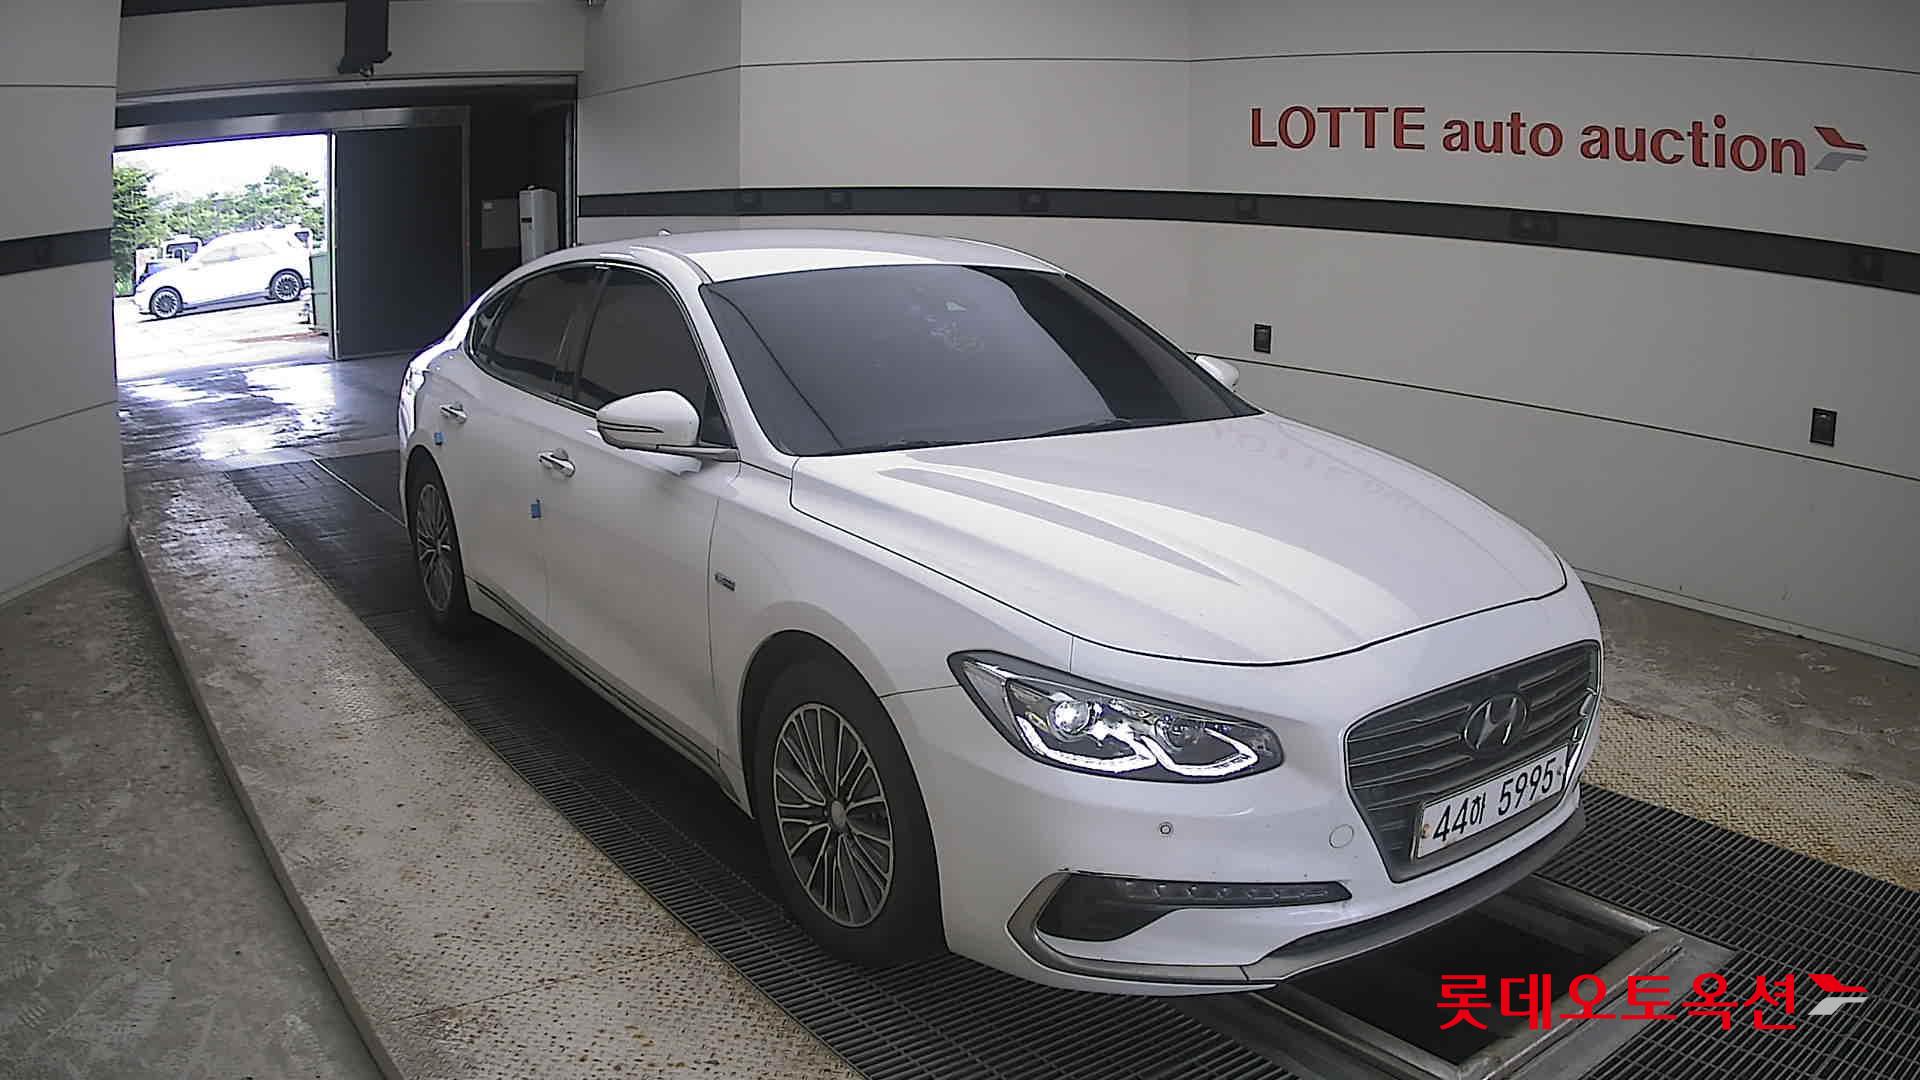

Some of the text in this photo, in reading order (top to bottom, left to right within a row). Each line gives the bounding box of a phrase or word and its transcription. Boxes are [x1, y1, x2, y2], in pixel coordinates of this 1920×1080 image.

[1250, 105, 1808, 177] LOTTE auto auction
[1432, 757, 1557, 842] 44하 5995
